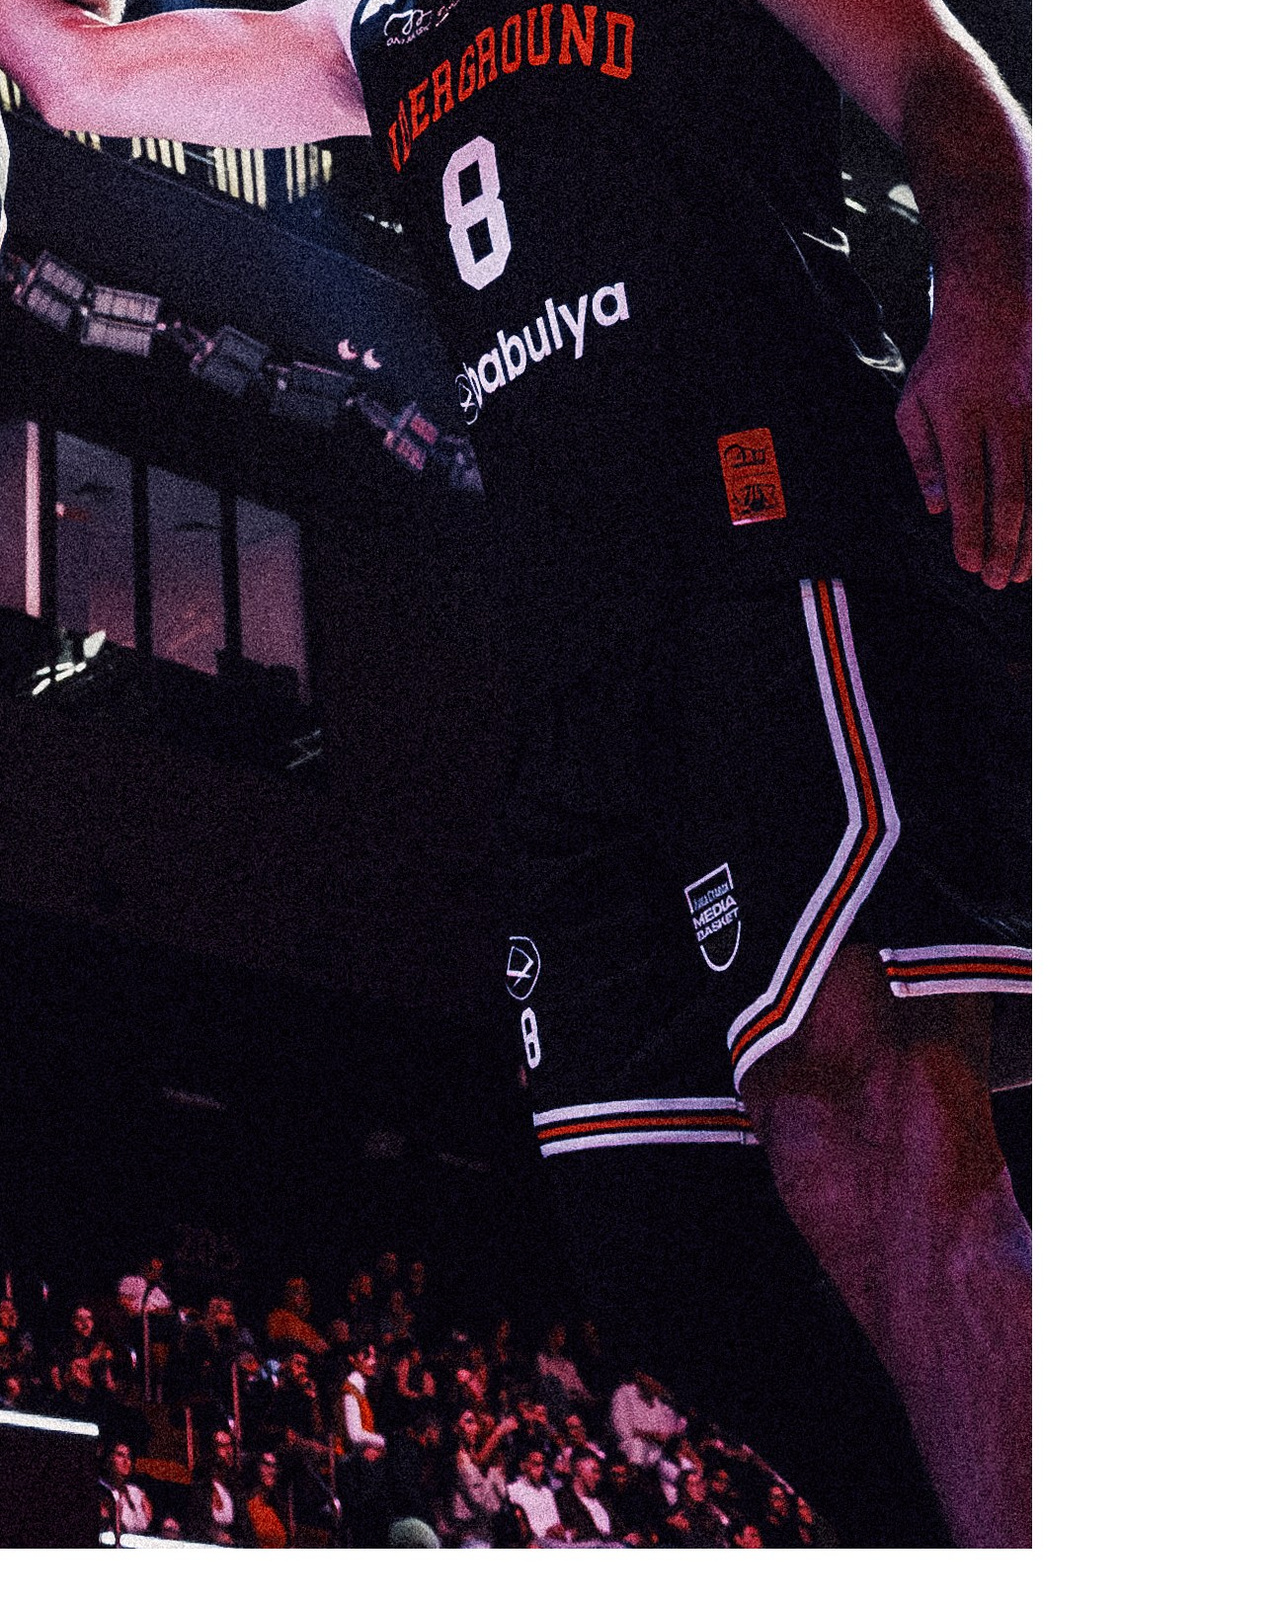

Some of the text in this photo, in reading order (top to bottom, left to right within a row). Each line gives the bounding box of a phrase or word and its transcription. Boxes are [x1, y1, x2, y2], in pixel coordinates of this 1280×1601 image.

[442, 135, 512, 291] 8
[692, 895, 737, 930] MEDIA
[696, 907, 739, 942] BASKET
[521, 1006, 542, 1069] 8
